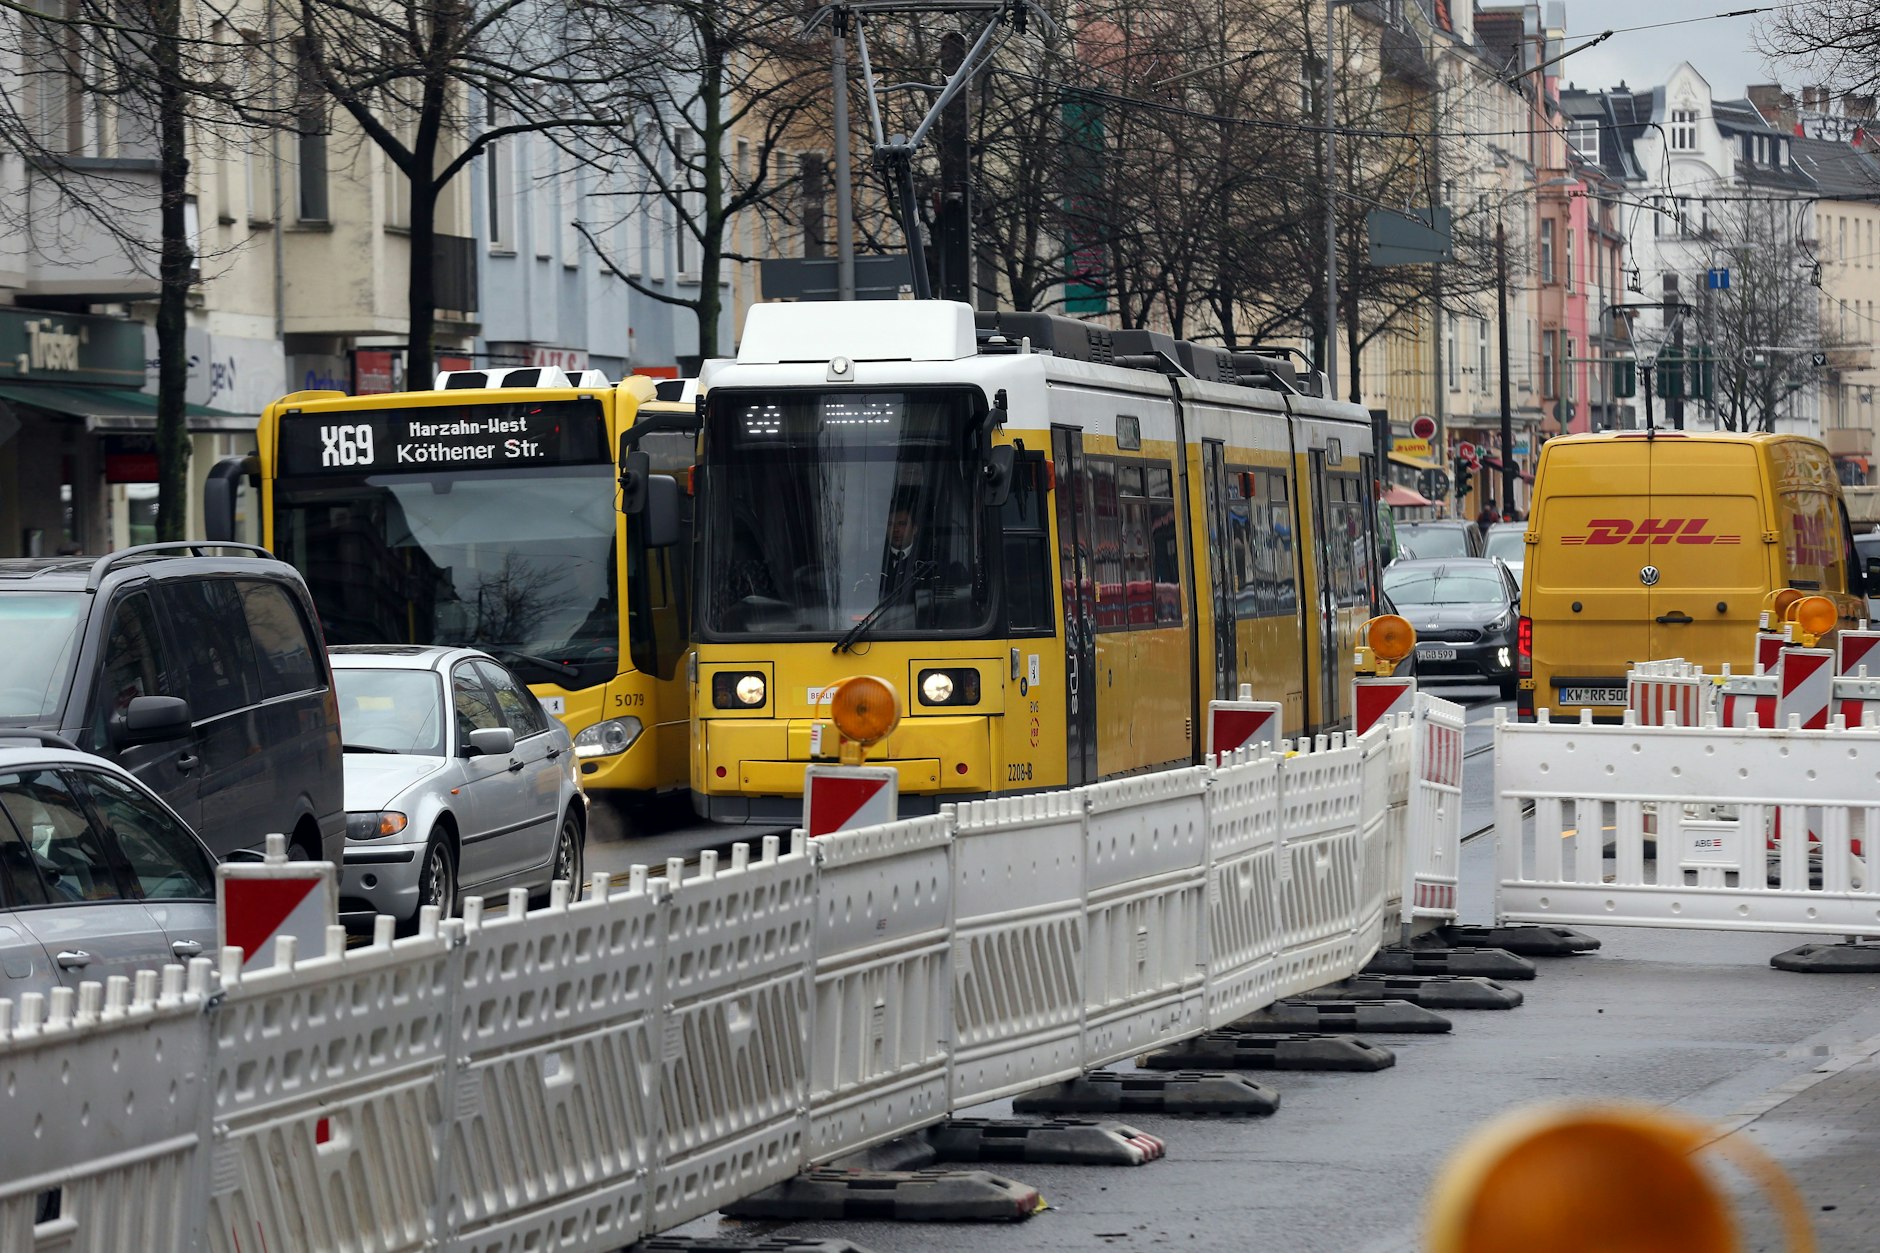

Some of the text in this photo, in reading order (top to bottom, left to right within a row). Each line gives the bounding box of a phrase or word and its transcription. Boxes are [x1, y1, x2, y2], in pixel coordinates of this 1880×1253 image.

[409, 416, 528, 437] Marzahn-West
[320, 424, 374, 467] X69
[396, 438, 545, 464] Köthener Str.
[1584, 518, 1717, 545] DHL
[615, 693, 645, 707] 5079
[1567, 689, 1583, 701] KW
[1590, 689, 1606, 701] RR
